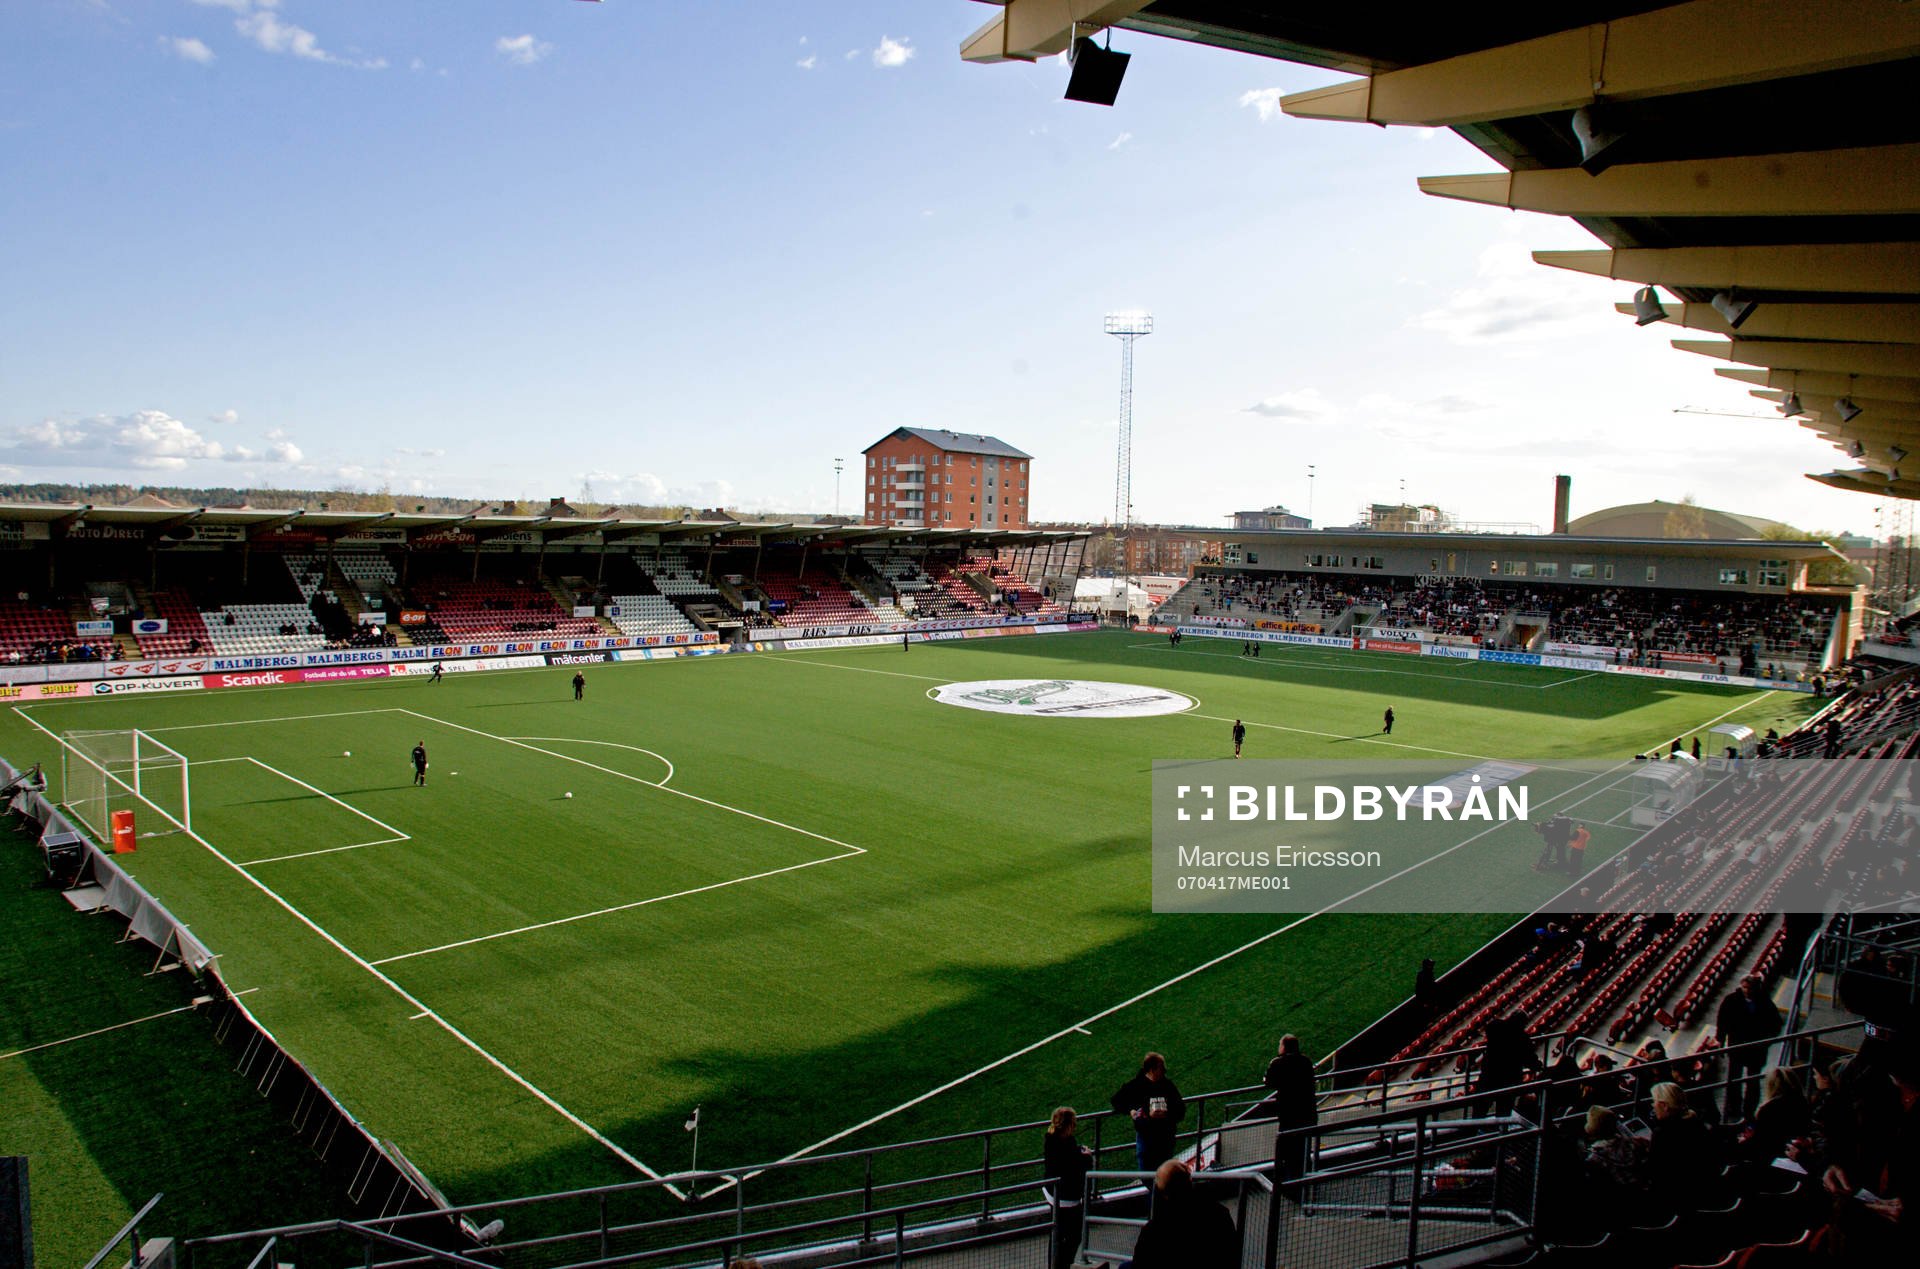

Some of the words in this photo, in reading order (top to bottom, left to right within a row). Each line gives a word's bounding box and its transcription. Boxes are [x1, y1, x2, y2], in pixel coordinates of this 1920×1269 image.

[102, 524, 144, 539] DIRECT
[1261, 621, 1283, 630] office
[1222, 630, 1264, 640] MALMBERGS
[1268, 633, 1312, 643] MALMBERGS
[431, 647, 462, 657] ELON
[469, 645, 499, 655] ELON
[505, 643, 534, 653] ELON
[540, 641, 567, 650] ELON
[573, 639, 600, 649] ELON
[605, 637, 631, 647] ELON
[636, 636, 660, 646] ELON
[666, 635, 689, 644] ELON
[694, 633, 718, 643] ELON
[1431, 645, 1468, 658] Folksam
[213, 656, 298, 669] MALMBERGS
[306, 651, 383, 664] MALMBERGS
[391, 649, 424, 659] MALM
[551, 653, 606, 666] mätcenter
[115, 680, 200, 691] OP-KUVERT
[222, 671, 285, 687] Scandic
[41, 683, 78, 695] SPORT
